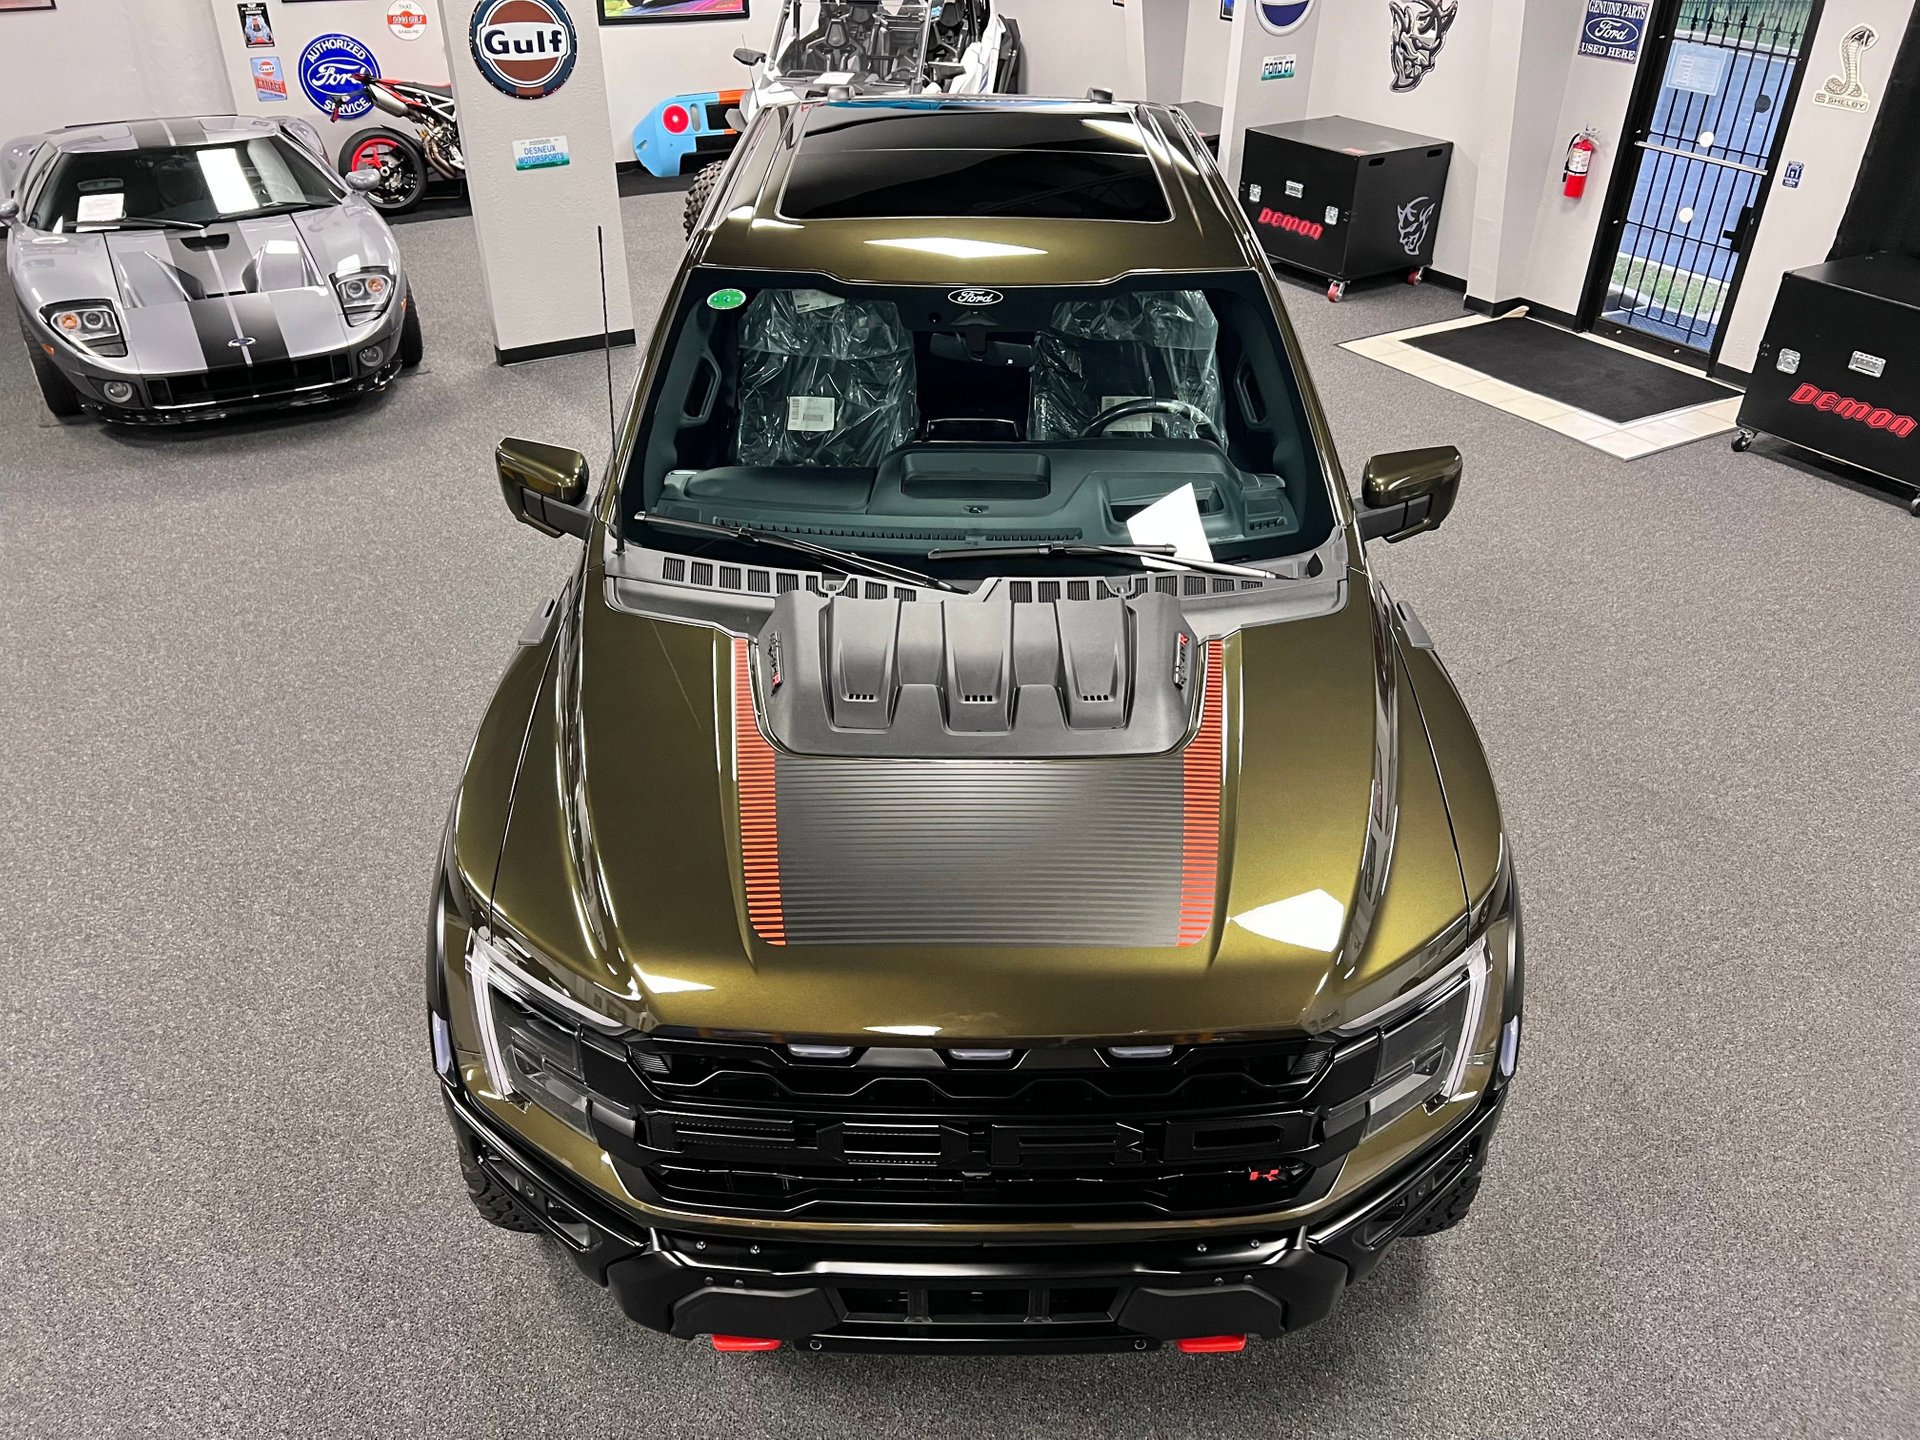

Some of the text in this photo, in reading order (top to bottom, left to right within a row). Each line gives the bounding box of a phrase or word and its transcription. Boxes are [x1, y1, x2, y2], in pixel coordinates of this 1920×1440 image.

[1589, 0, 1646, 20] GENUINE PARTS
[1594, 20, 1630, 40] Ford
[307, 39, 366, 64] AUTHORIZED
[484, 29, 563, 55] Gulf
[1581, 42, 1635, 60] USED HERE
[1264, 61, 1294, 75] FORD GT
[518, 152, 565, 165] MOTORSPORTS
[1258, 207, 1323, 240] DEMON
[957, 290, 994, 302] Ford
[1789, 382, 1918, 438] DEMON
